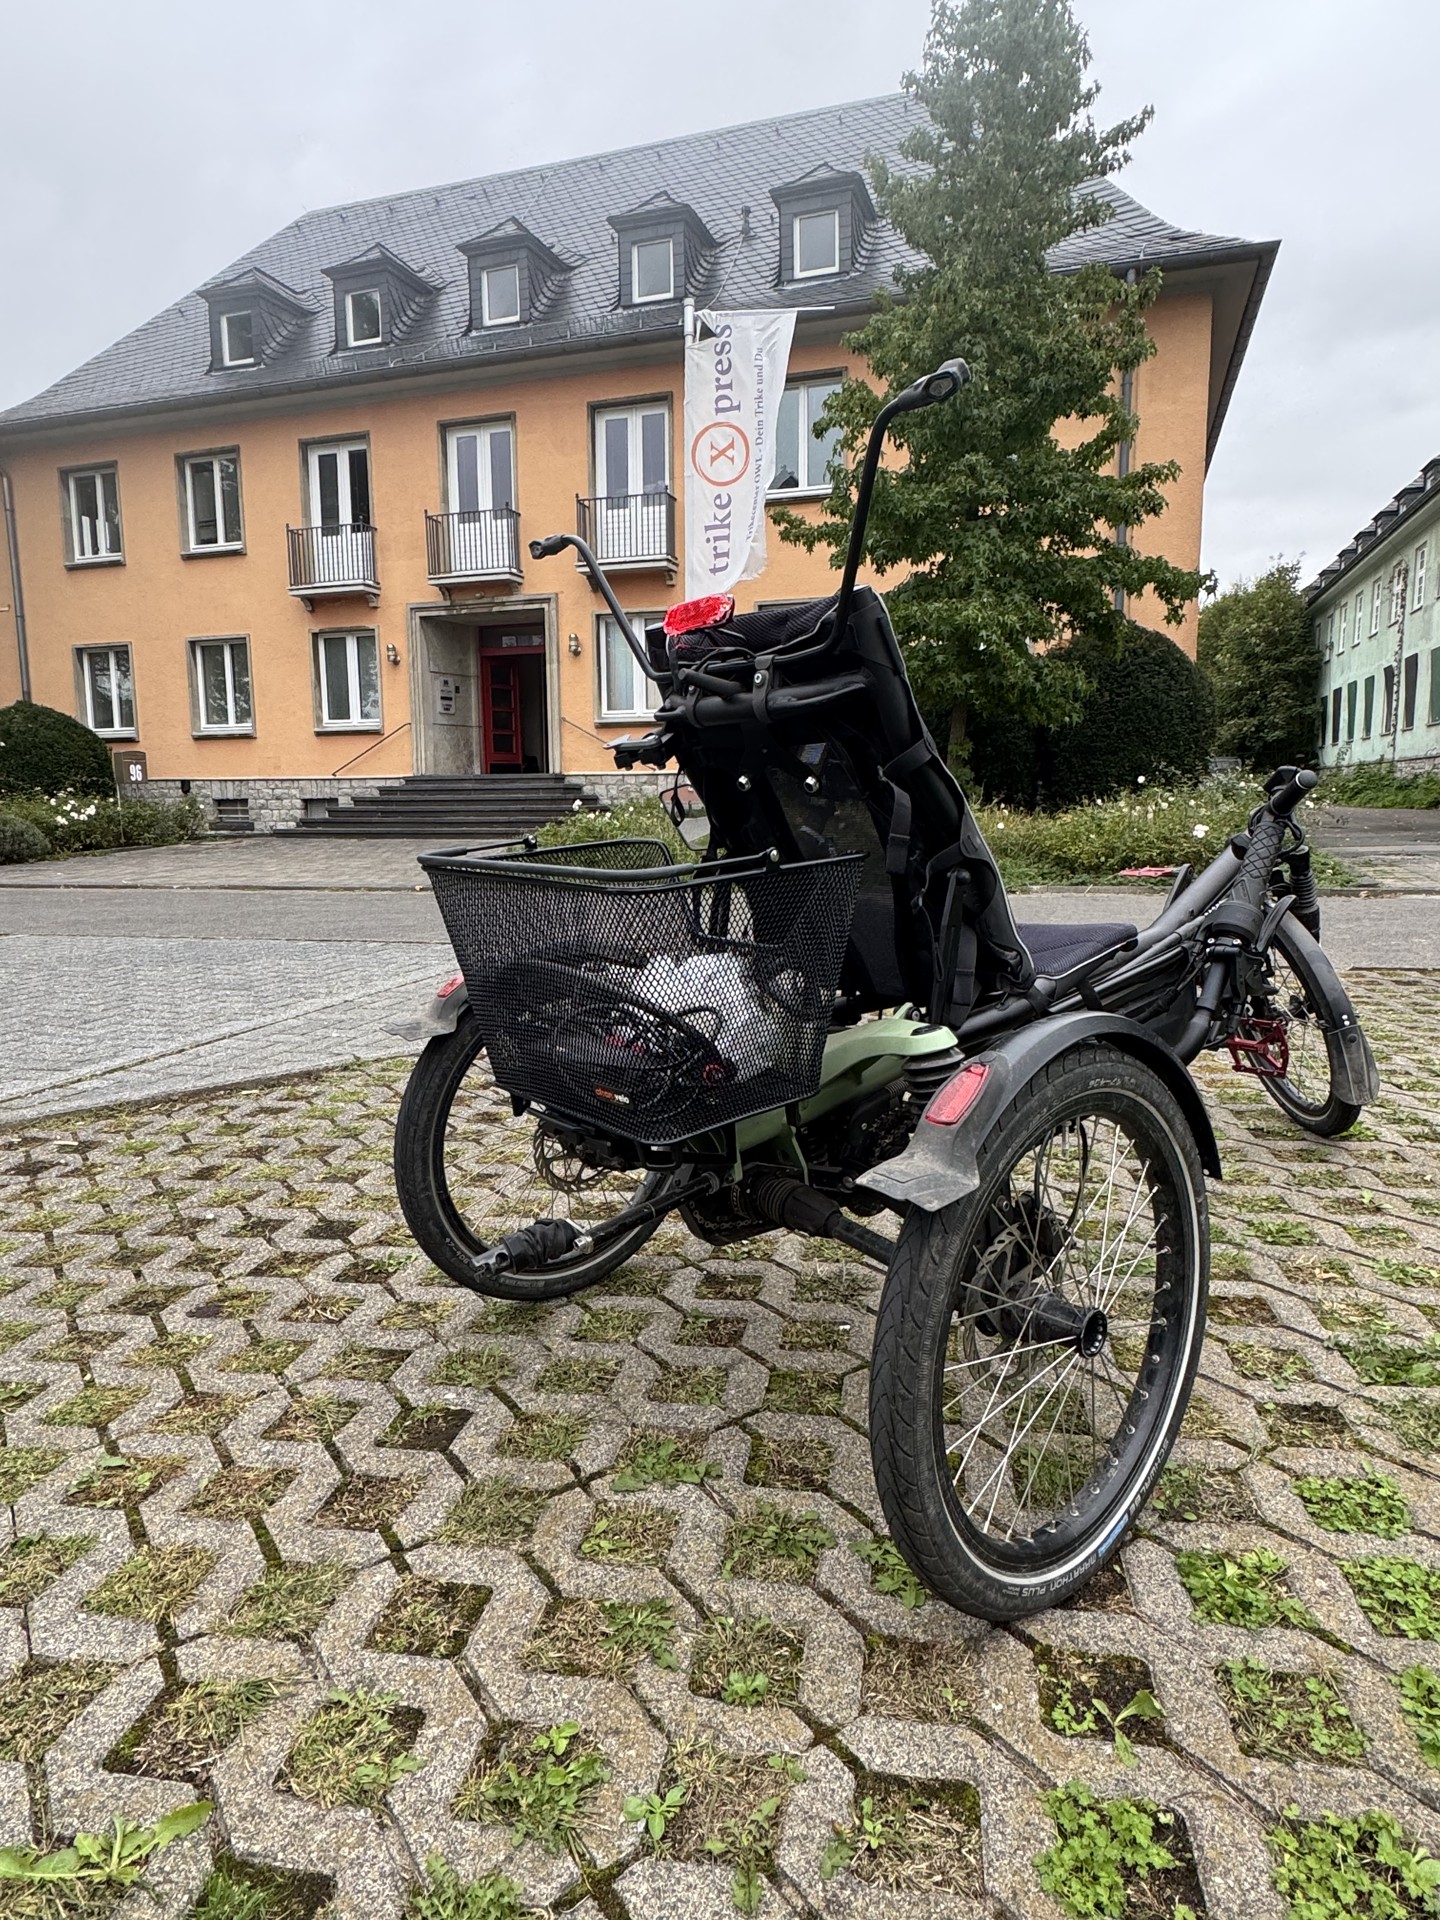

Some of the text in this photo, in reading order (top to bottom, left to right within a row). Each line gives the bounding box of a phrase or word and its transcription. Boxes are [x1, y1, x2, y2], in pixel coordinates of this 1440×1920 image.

[754, 347, 764, 361] Du
[714, 323, 742, 416] press
[754, 364, 764, 386] und
[754, 387, 764, 418] Trike
[755, 420, 764, 446] Dein
[754, 454, 763, 483] OWL
[704, 492, 733, 576] trike
[129, 764, 143, 781] 96
[1129, 1438, 1169, 1516] SCHWALBE
[1021, 1552, 1097, 1598] MARATHON PLUS
